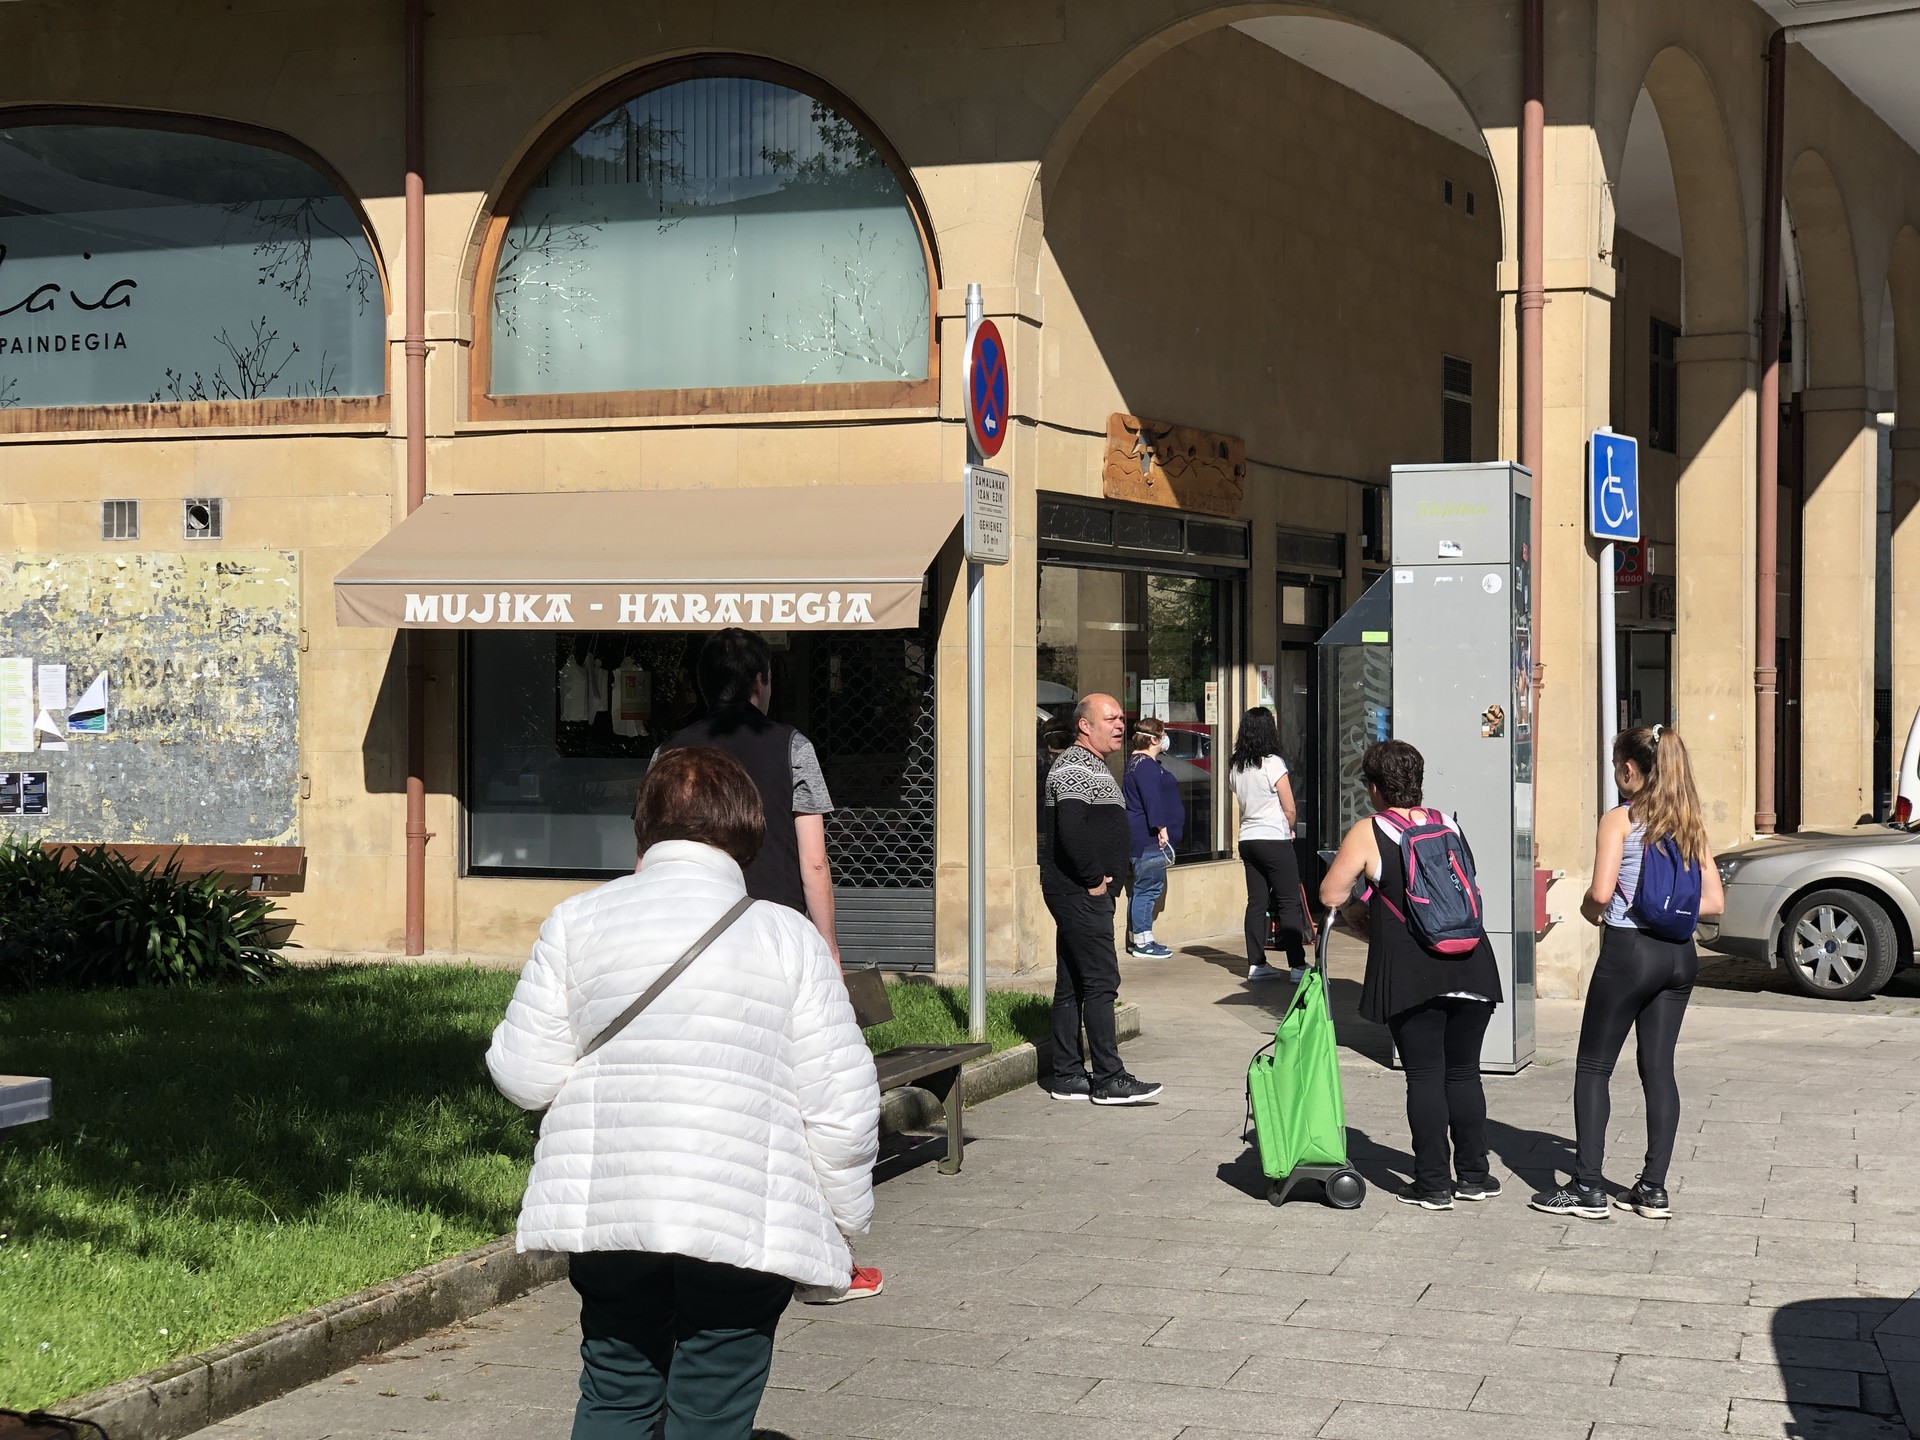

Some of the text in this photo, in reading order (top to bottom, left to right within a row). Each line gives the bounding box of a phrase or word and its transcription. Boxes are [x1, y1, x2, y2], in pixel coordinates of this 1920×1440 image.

[975, 475, 1006, 491] ZAMALANAK
[977, 489, 1003, 504] IZAN EZIK
[979, 519, 1003, 533] GEHIENEZ
[983, 533, 999, 546] 30 min
